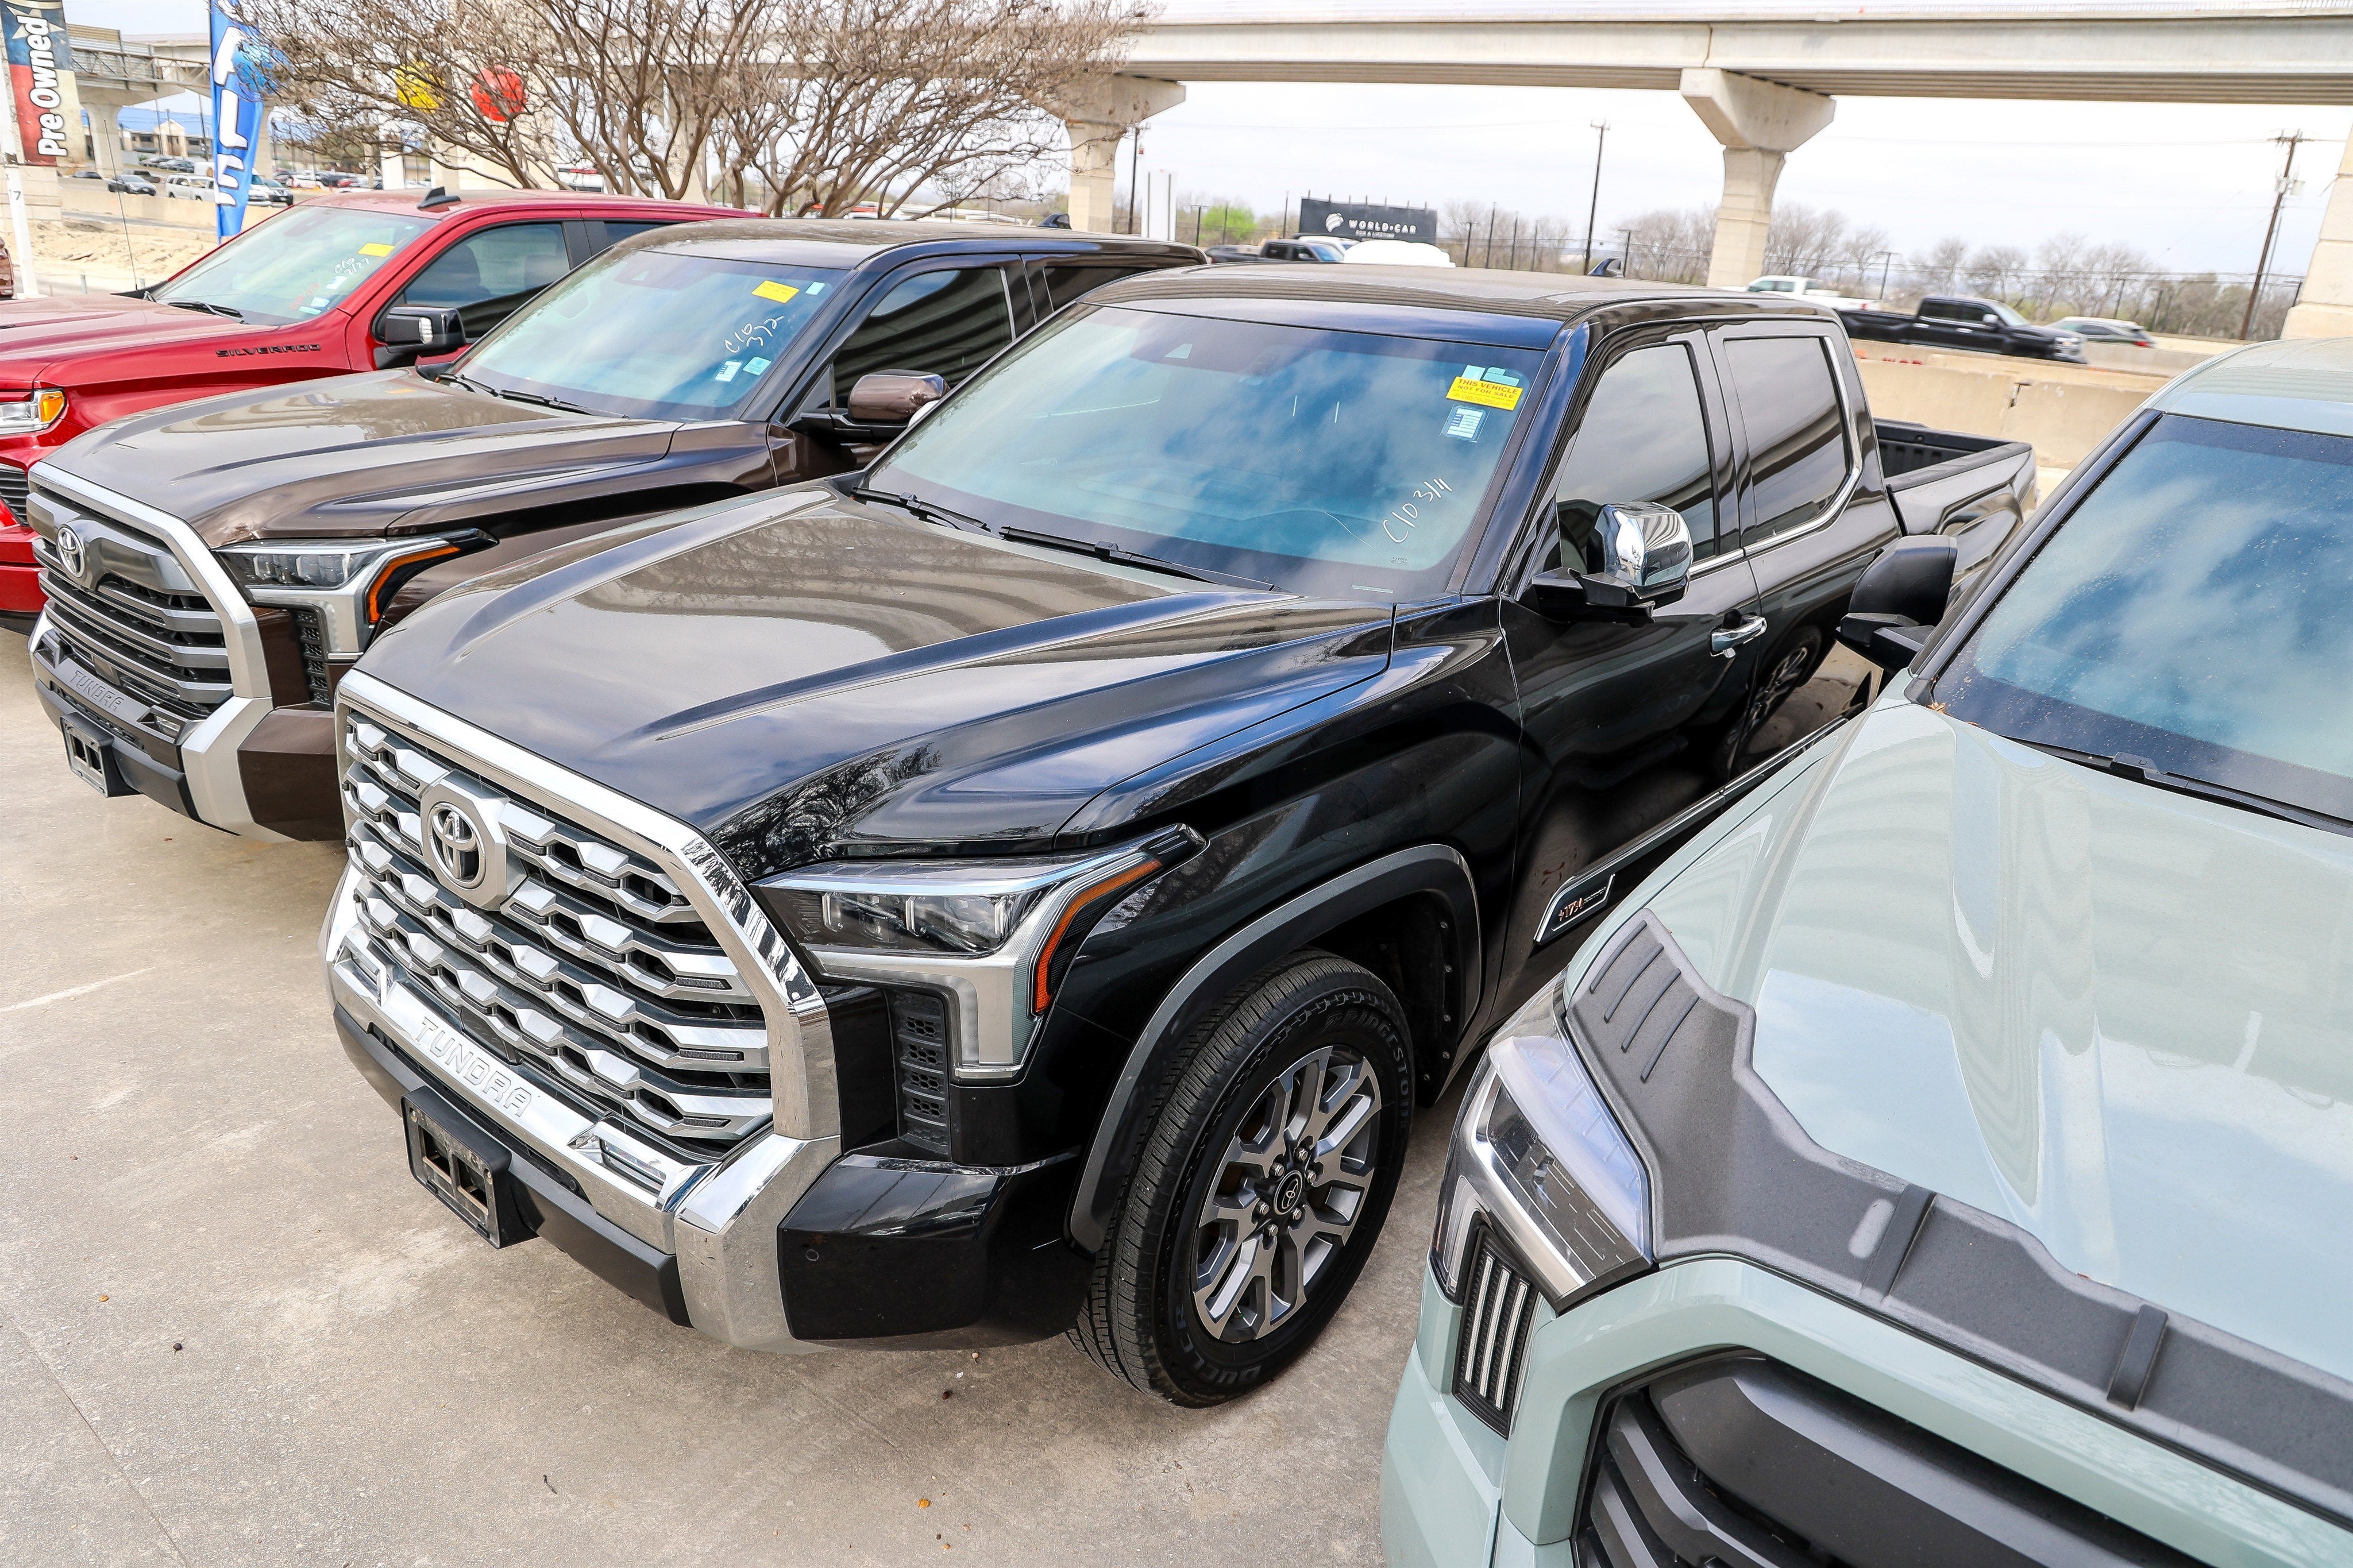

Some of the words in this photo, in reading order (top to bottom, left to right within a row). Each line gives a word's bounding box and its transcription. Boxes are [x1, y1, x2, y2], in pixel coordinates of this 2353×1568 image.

[17, 15, 60, 109] Owned
[38, 113, 67, 157] Pre
[215, 344, 321, 357] SILVERADO
[1481, 383, 1519, 394] VEHICLE
[70, 670, 124, 712] TUNDRA
[415, 1016, 532, 1117] TUNDRA
